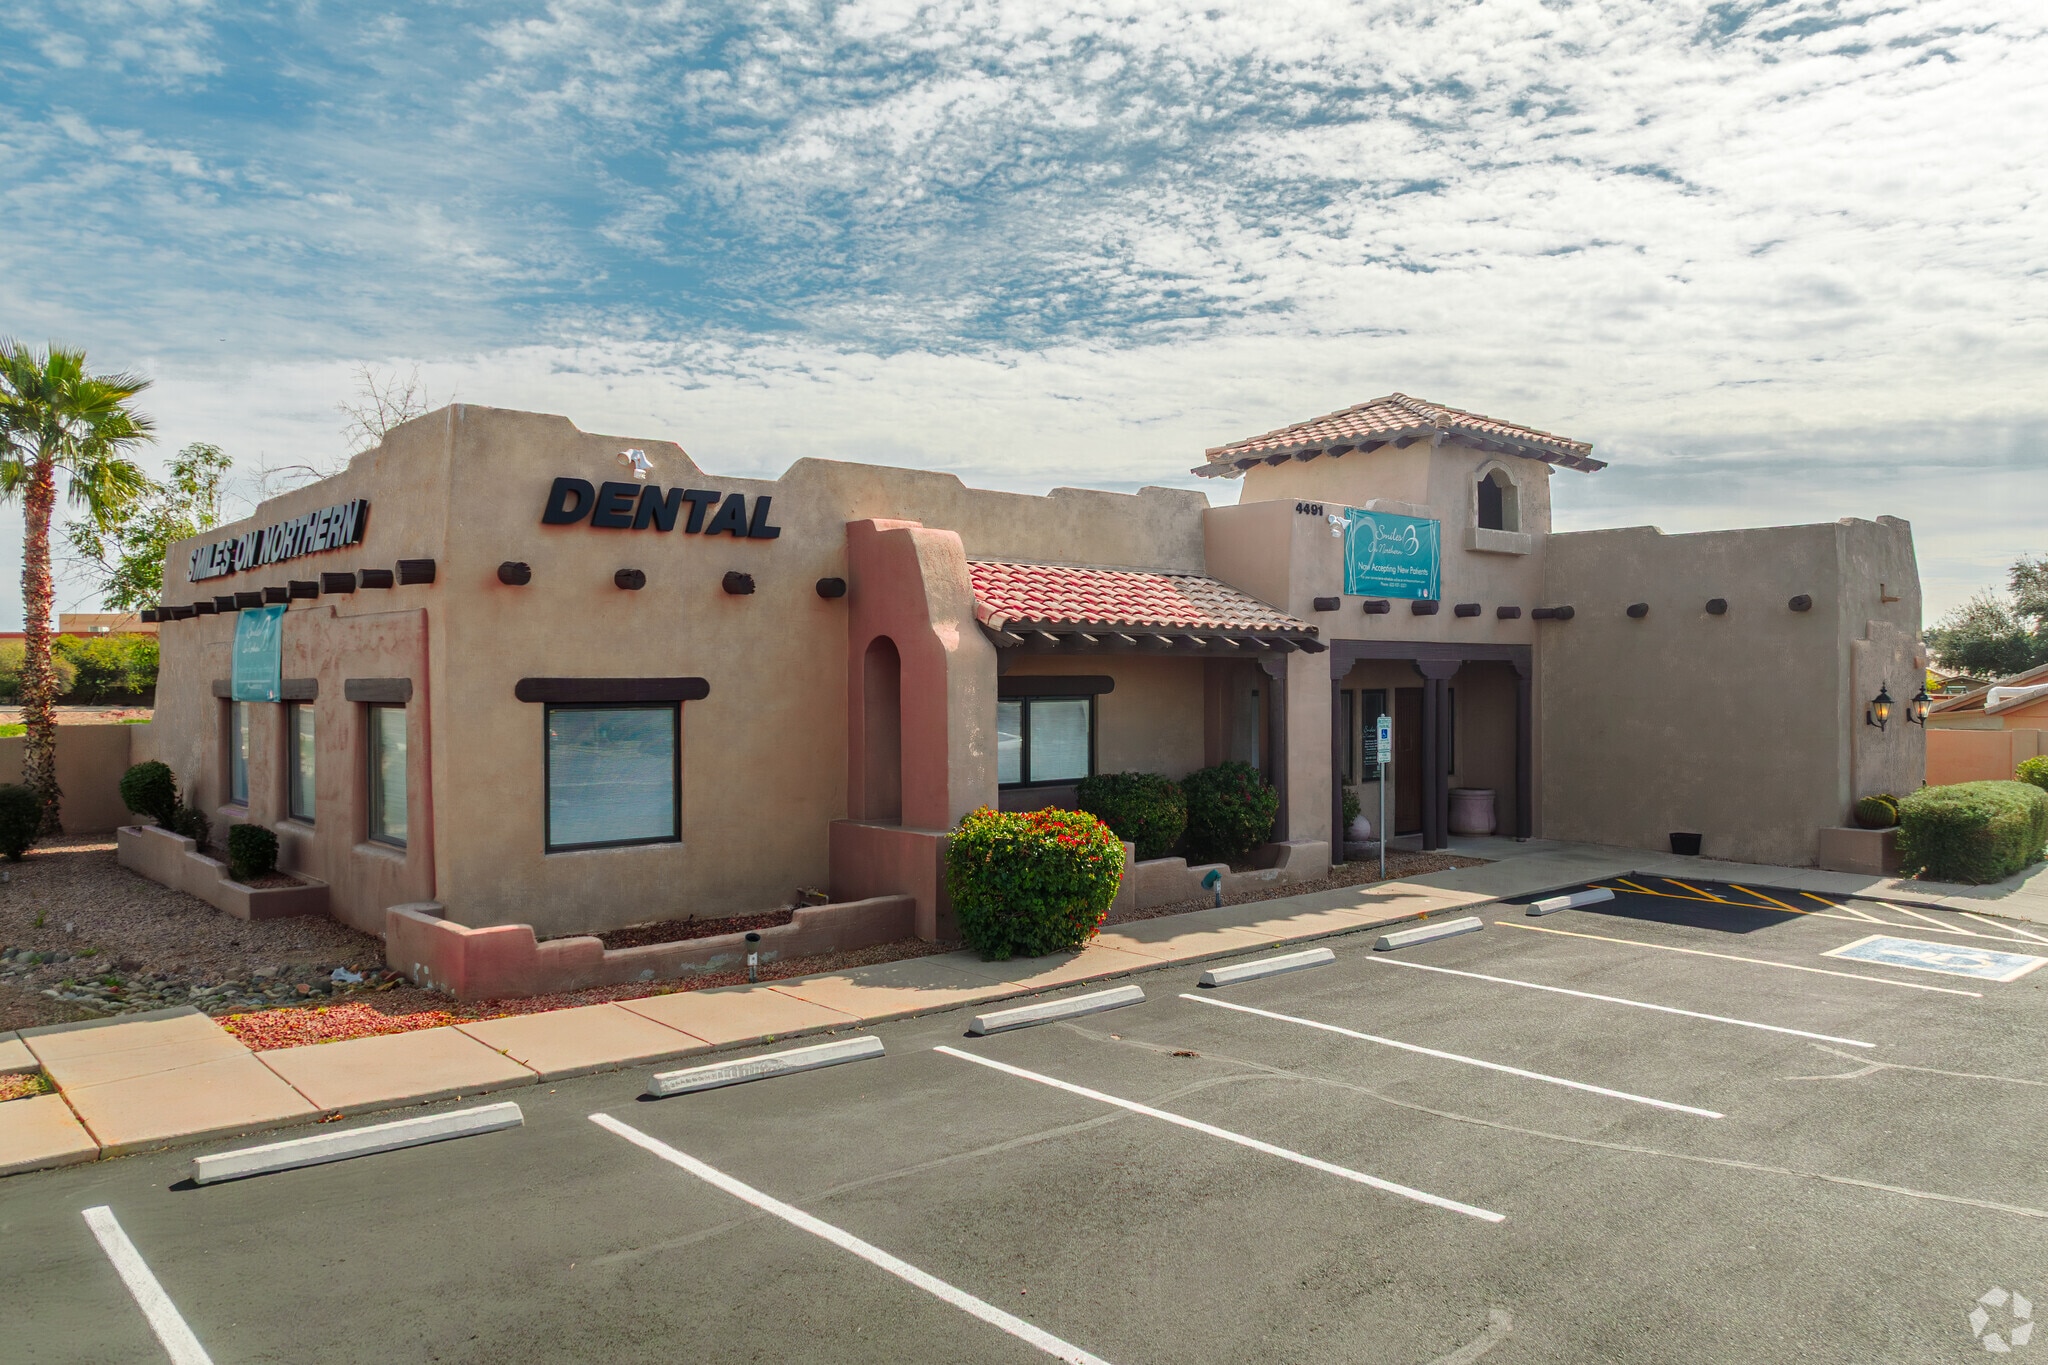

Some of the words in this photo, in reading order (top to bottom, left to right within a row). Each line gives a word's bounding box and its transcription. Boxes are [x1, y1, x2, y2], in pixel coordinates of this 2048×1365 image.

[542, 477, 781, 539] DENTAL
[1295, 502, 1324, 516] 4491
[187, 539, 237, 582] SMILES
[234, 530, 264, 571] ON
[259, 499, 368, 564] NORTHERN
[1375, 524, 1403, 542] Smiles
[1368, 541, 1378, 553] On
[1379, 543, 1403, 555] Northern
[1358, 562, 1371, 571] Now
[1371, 563, 1397, 575] Accepting
[1397, 565, 1409, 574] New
[1409, 566, 1429, 576] Patients
